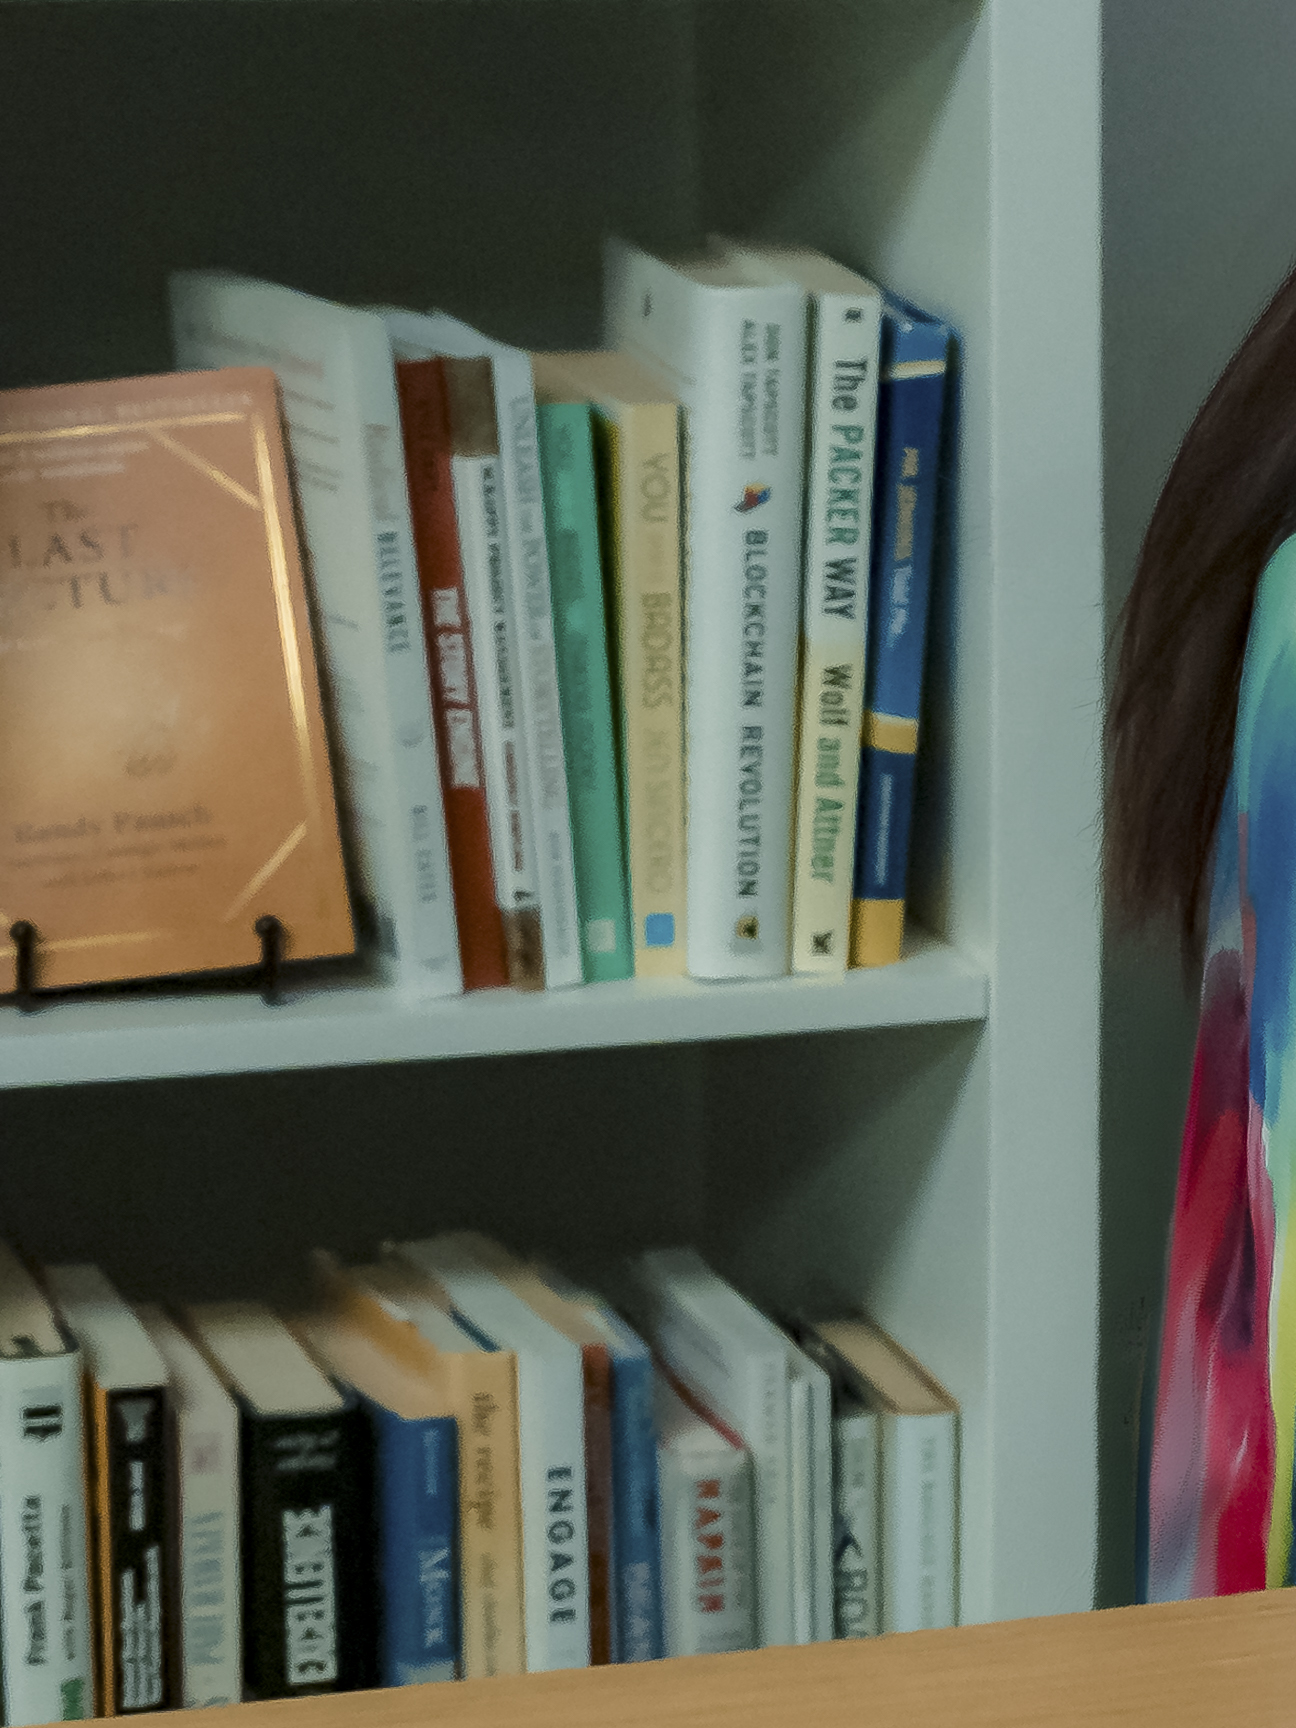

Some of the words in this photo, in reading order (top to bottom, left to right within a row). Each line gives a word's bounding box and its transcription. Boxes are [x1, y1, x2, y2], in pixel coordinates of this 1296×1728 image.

[831, 358, 868, 413] The
[639, 450, 670, 525] YOU
[825, 425, 864, 549] PACKER
[4, 524, 140, 570] LAST
[823, 555, 860, 622] WAY
[641, 591, 672, 710] BADASS
[742, 529, 770, 709] BLOCKCHAIN
[818, 661, 854, 730] Wolf
[817, 737, 846, 788] and
[737, 725, 764, 901] REVOLUTION
[810, 792, 845, 885] Attner
[546, 1466, 577, 1623] ENGAGE
[696, 1479, 724, 1613] NAPKIN
[23, 1601, 48, 1667] Frank
